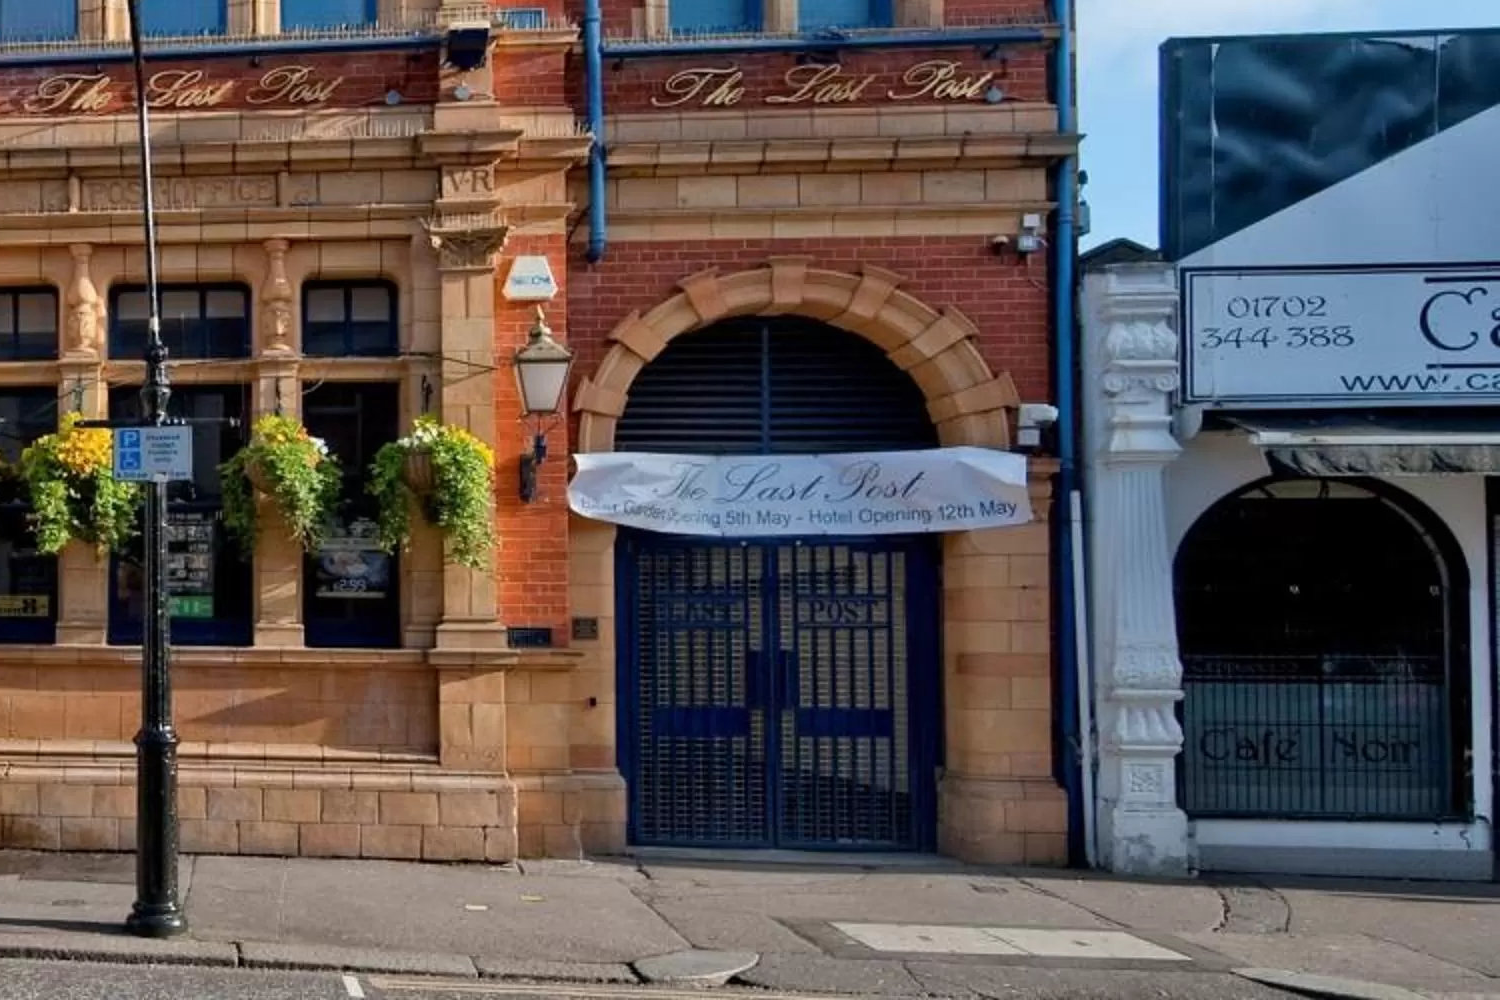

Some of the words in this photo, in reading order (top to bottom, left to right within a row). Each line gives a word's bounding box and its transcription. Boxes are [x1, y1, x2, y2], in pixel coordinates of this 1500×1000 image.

[24, 73, 113, 112] The
[146, 69, 239, 107] Last
[245, 65, 343, 103] Post
[651, 66, 746, 107] The
[765, 63, 875, 103] Last
[887, 60, 994, 100] Post
[1227, 295, 1327, 318] 01702
[1201, 326, 1277, 349] 344
[1284, 325, 1355, 348] 388
[652, 460, 709, 502] The
[713, 462, 824, 504] Last
[824, 460, 927, 502] Post
[726, 509, 751, 525] 5th
[756, 509, 791, 528] May
[809, 508, 853, 524] Hotel
[858, 507, 932, 525] Opening
[938, 503, 974, 520] 12th
[979, 500, 1017, 518] May
[808, 599, 879, 623] POST
